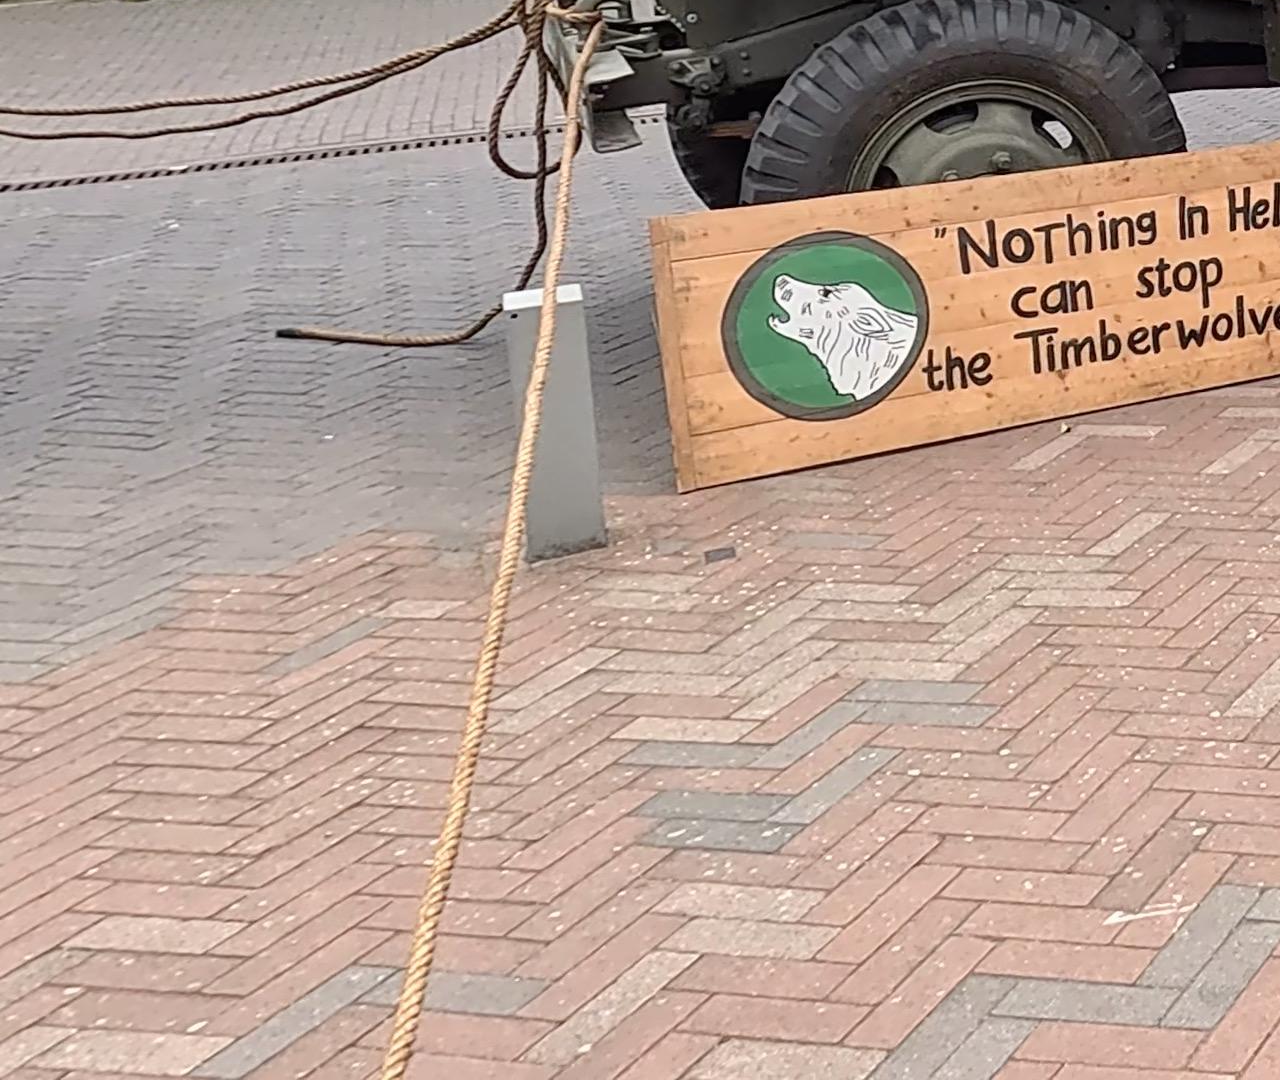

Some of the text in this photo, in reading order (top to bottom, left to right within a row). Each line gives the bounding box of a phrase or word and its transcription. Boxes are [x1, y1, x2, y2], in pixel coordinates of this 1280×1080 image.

[1178, 195, 1210, 240] In
[1010, 256, 1224, 319] can stop
[921, 345, 994, 392] the
